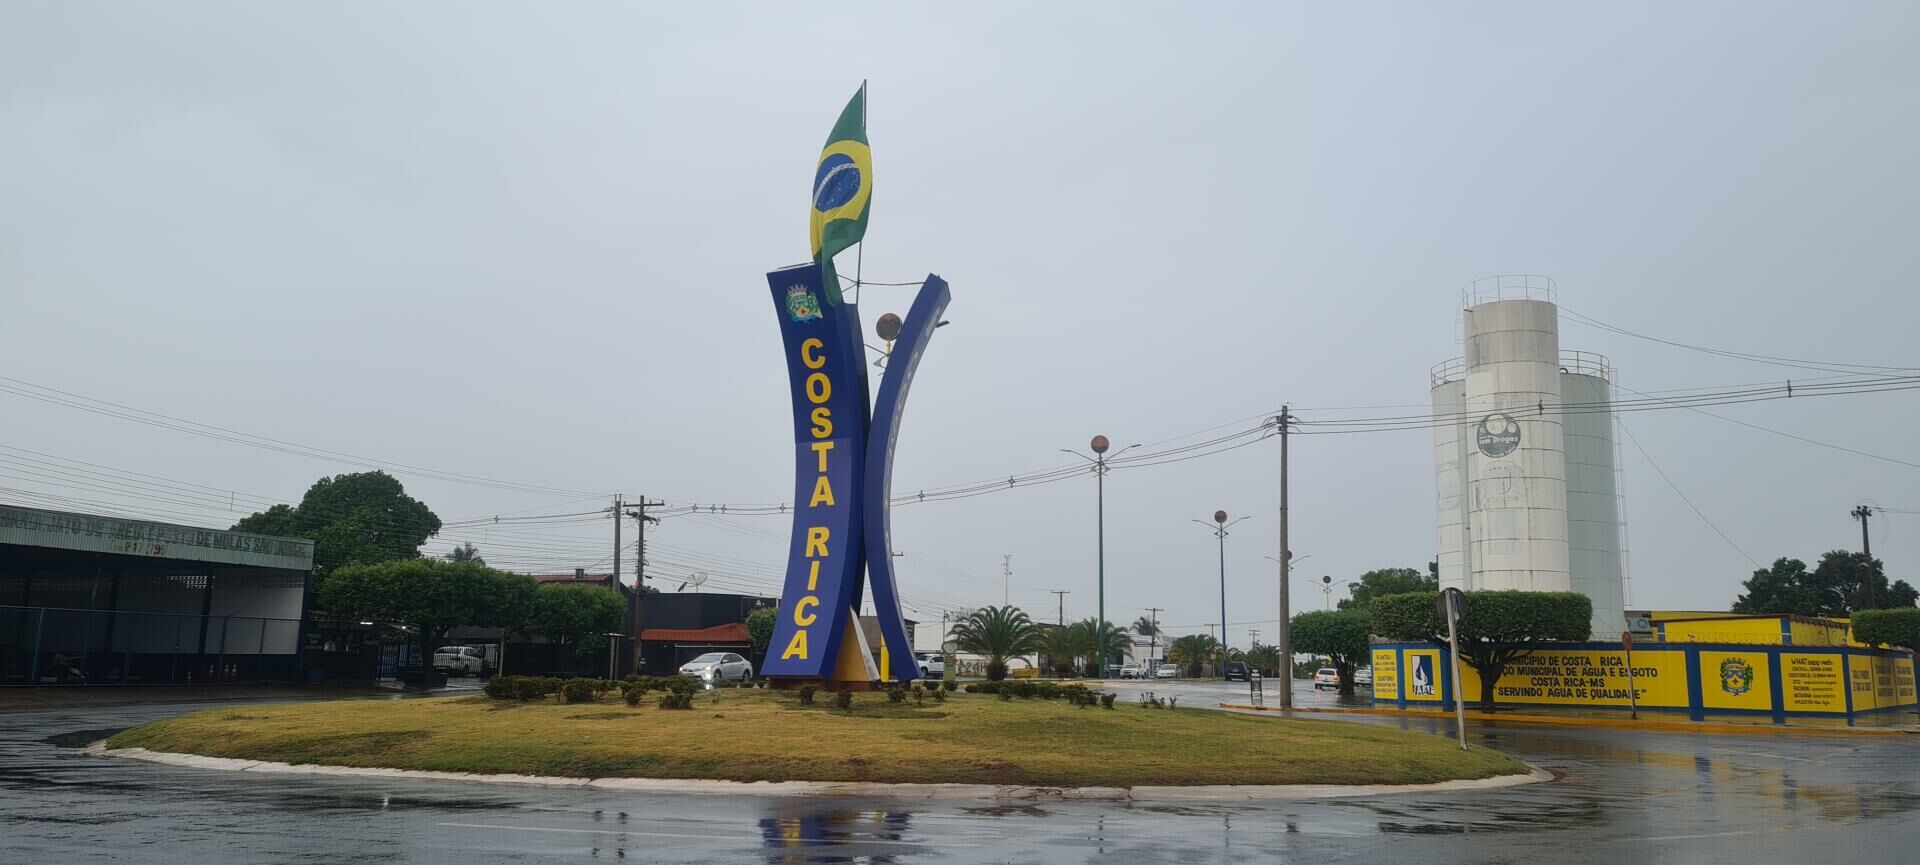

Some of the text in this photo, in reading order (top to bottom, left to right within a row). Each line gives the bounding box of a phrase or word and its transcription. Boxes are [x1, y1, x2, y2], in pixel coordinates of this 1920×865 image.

[782, 338, 834, 659] COSTA RICA
[1548, 656, 1559, 666] DE
[1562, 656, 1592, 666] COSTA
[1600, 656, 1623, 666] RICA
[1517, 666, 1564, 676] MUNICIPAL
[1566, 667, 1576, 677] DE
[1610, 667, 1615, 677] E
[1531, 677, 1605, 688] COSTA RICA-MS
[1576, 688, 1587, 698] DE
